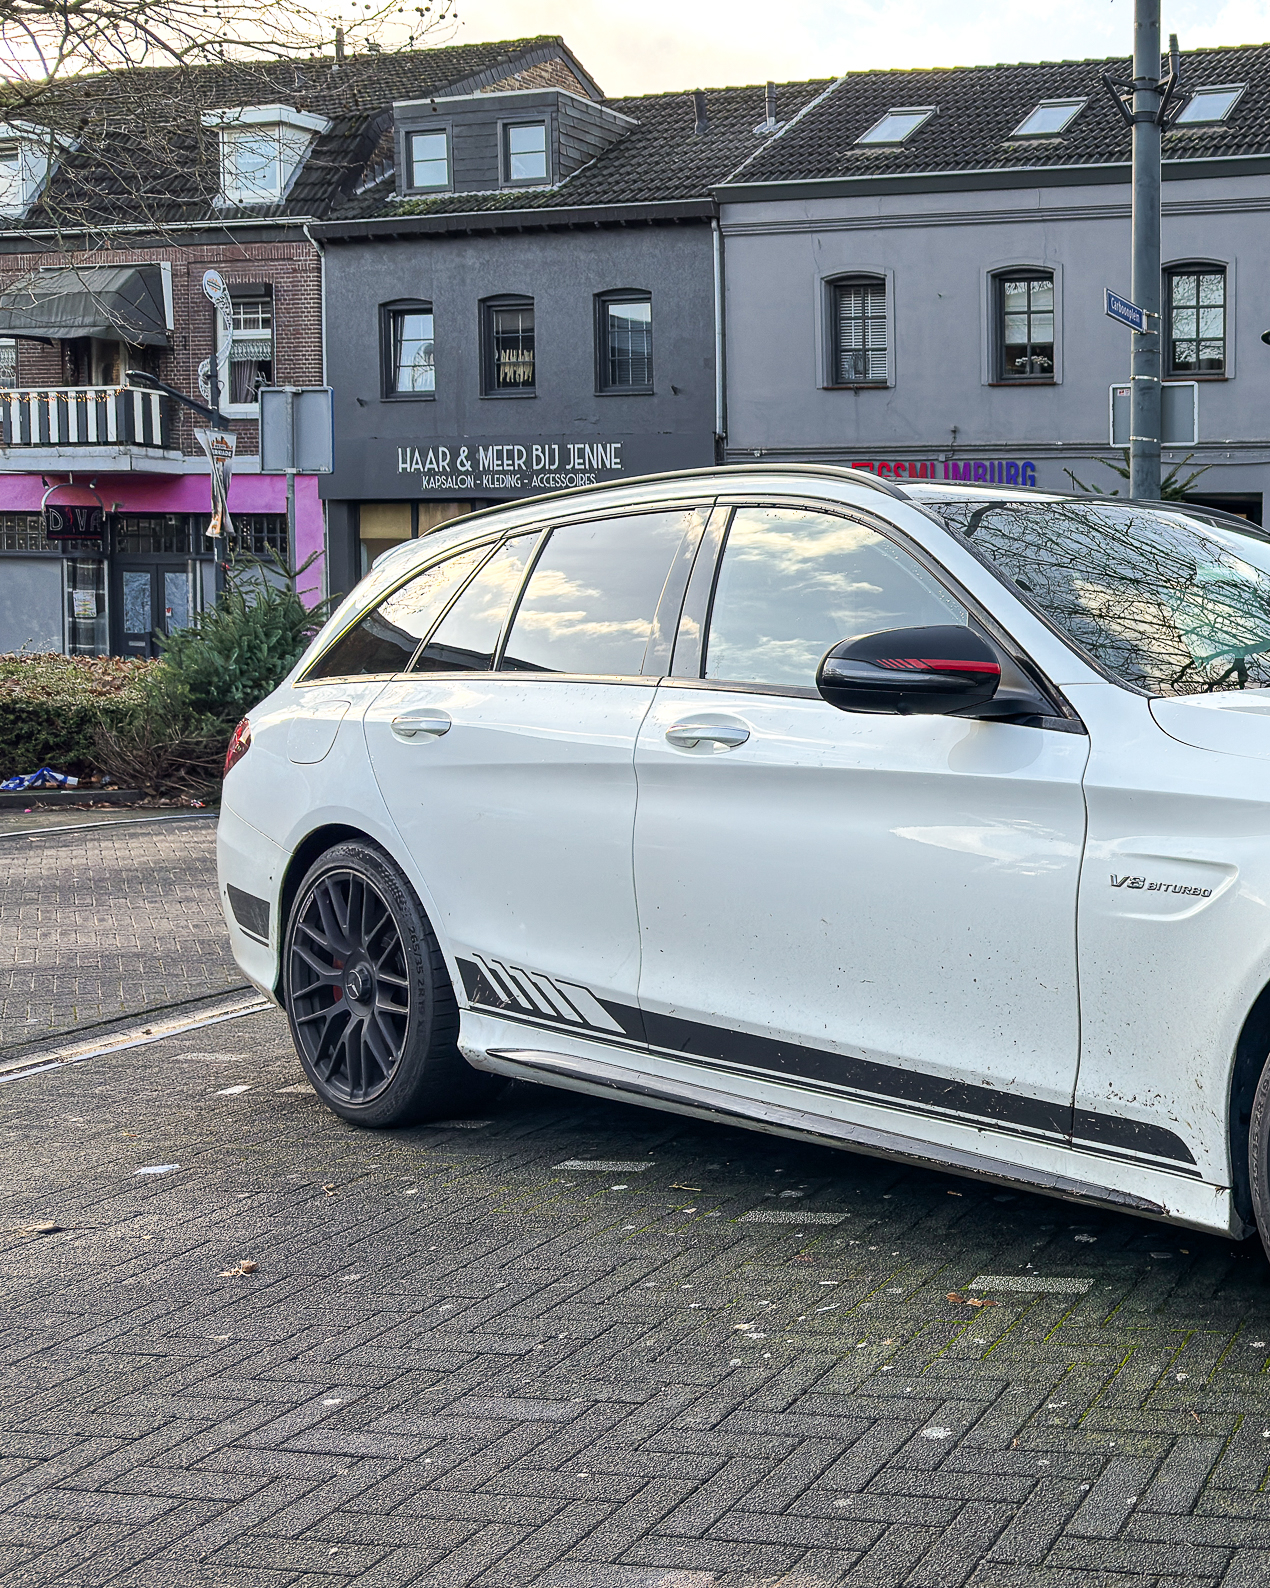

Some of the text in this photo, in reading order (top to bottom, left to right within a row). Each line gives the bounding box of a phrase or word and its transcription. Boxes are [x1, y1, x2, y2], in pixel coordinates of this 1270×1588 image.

[397, 443, 622, 473] HAAR & MEER BIJ JENNE
[422, 474, 474, 489] KAPSALON
[482, 474, 521, 488] KLEDING
[531, 473, 597, 488] ACCESSOIRES
[1110, 874, 1213, 898] V8 BITURBO
